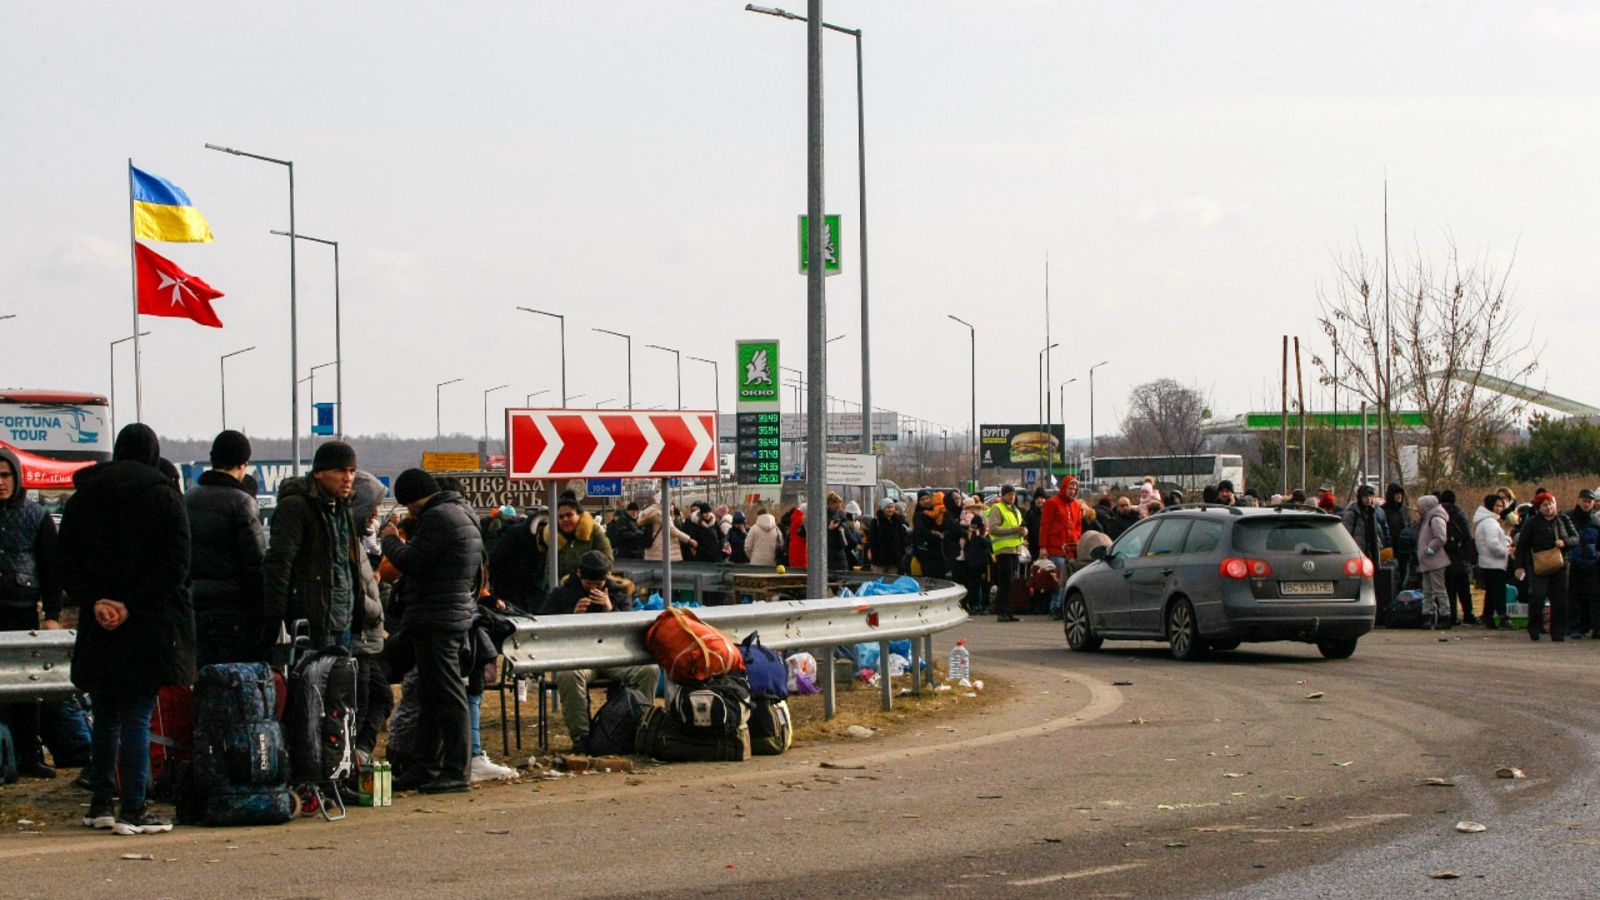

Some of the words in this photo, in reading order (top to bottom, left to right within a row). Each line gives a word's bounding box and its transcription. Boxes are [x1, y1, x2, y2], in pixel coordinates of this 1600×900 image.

[10, 429, 47, 441] TOUR
[982, 428, 1009, 437] БУРГЕР
[460, 477, 545, 492] ВІВСЬКА
